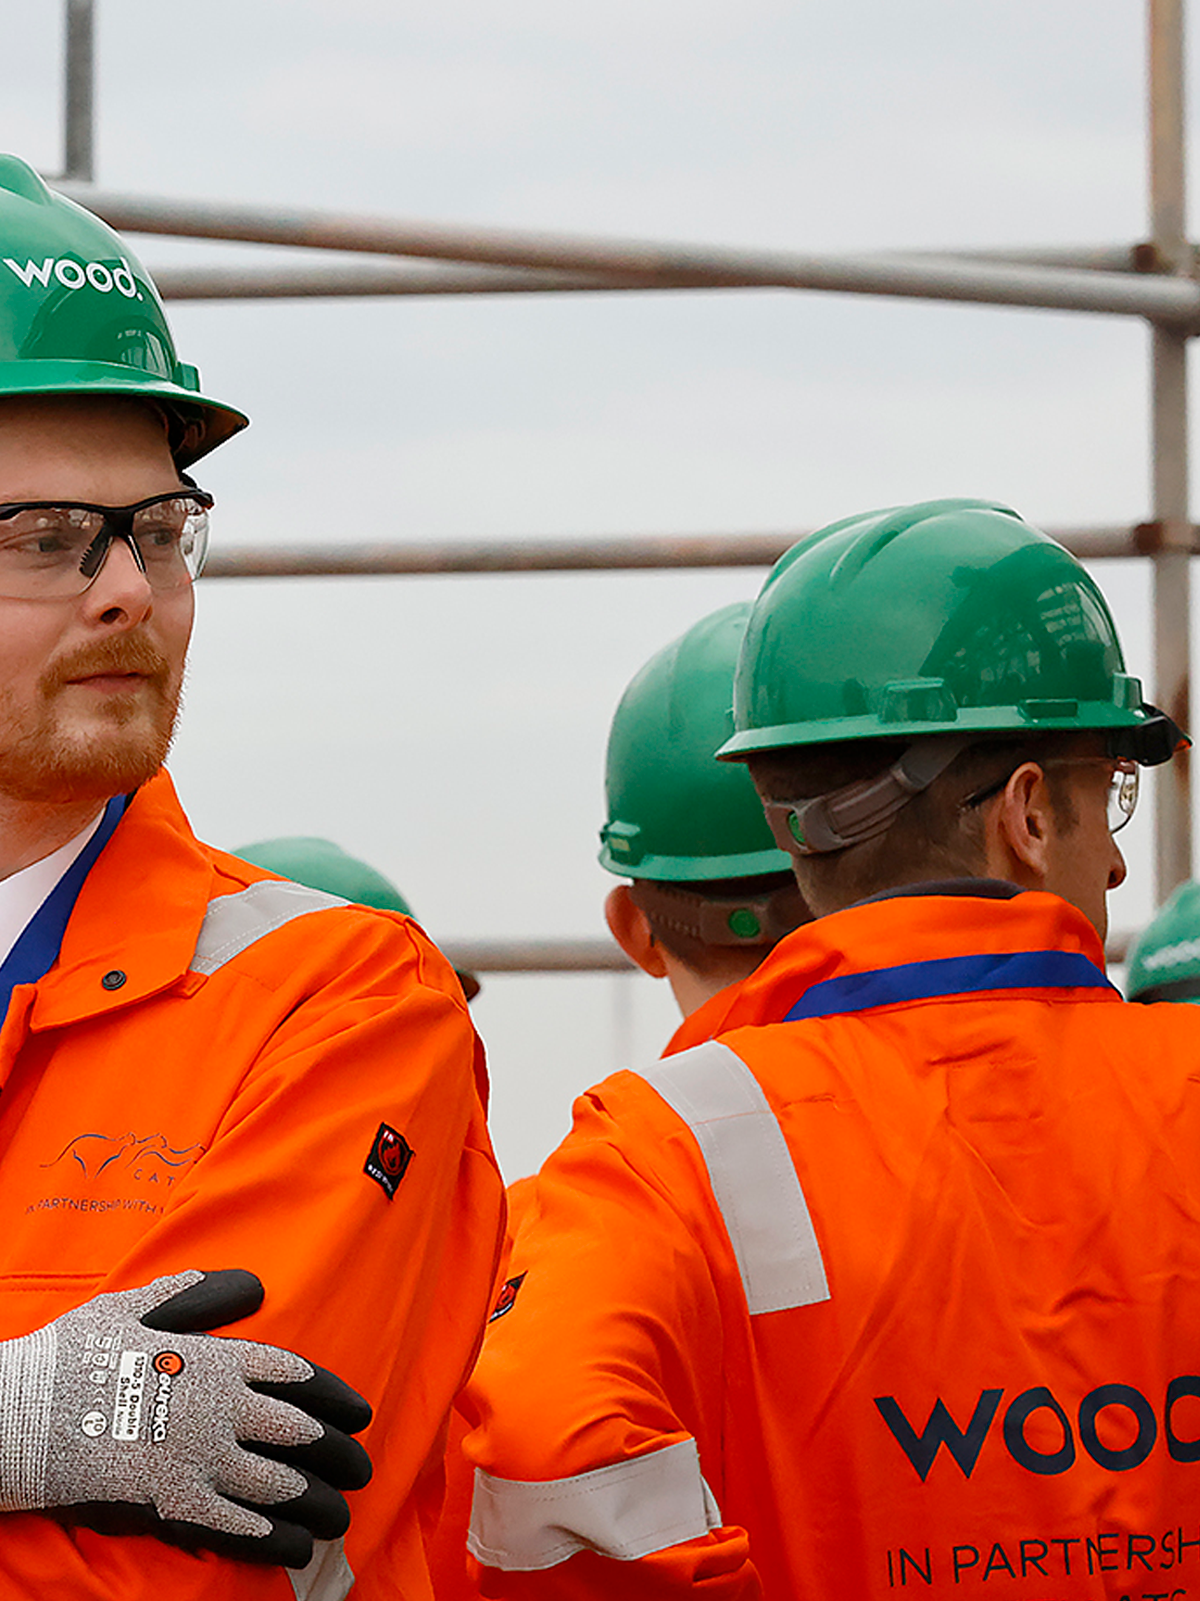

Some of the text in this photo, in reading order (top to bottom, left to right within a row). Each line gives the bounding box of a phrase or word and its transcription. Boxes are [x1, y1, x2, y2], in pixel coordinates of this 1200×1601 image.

[2, 256, 144, 302] wood.
[38, 1197, 122, 1213] PARTNERSHIP
[123, 1199, 157, 1214] WITH
[118, 1377, 131, 1408] Shell
[126, 1395, 140, 1435] Double
[886, 1547, 932, 1587] IN
